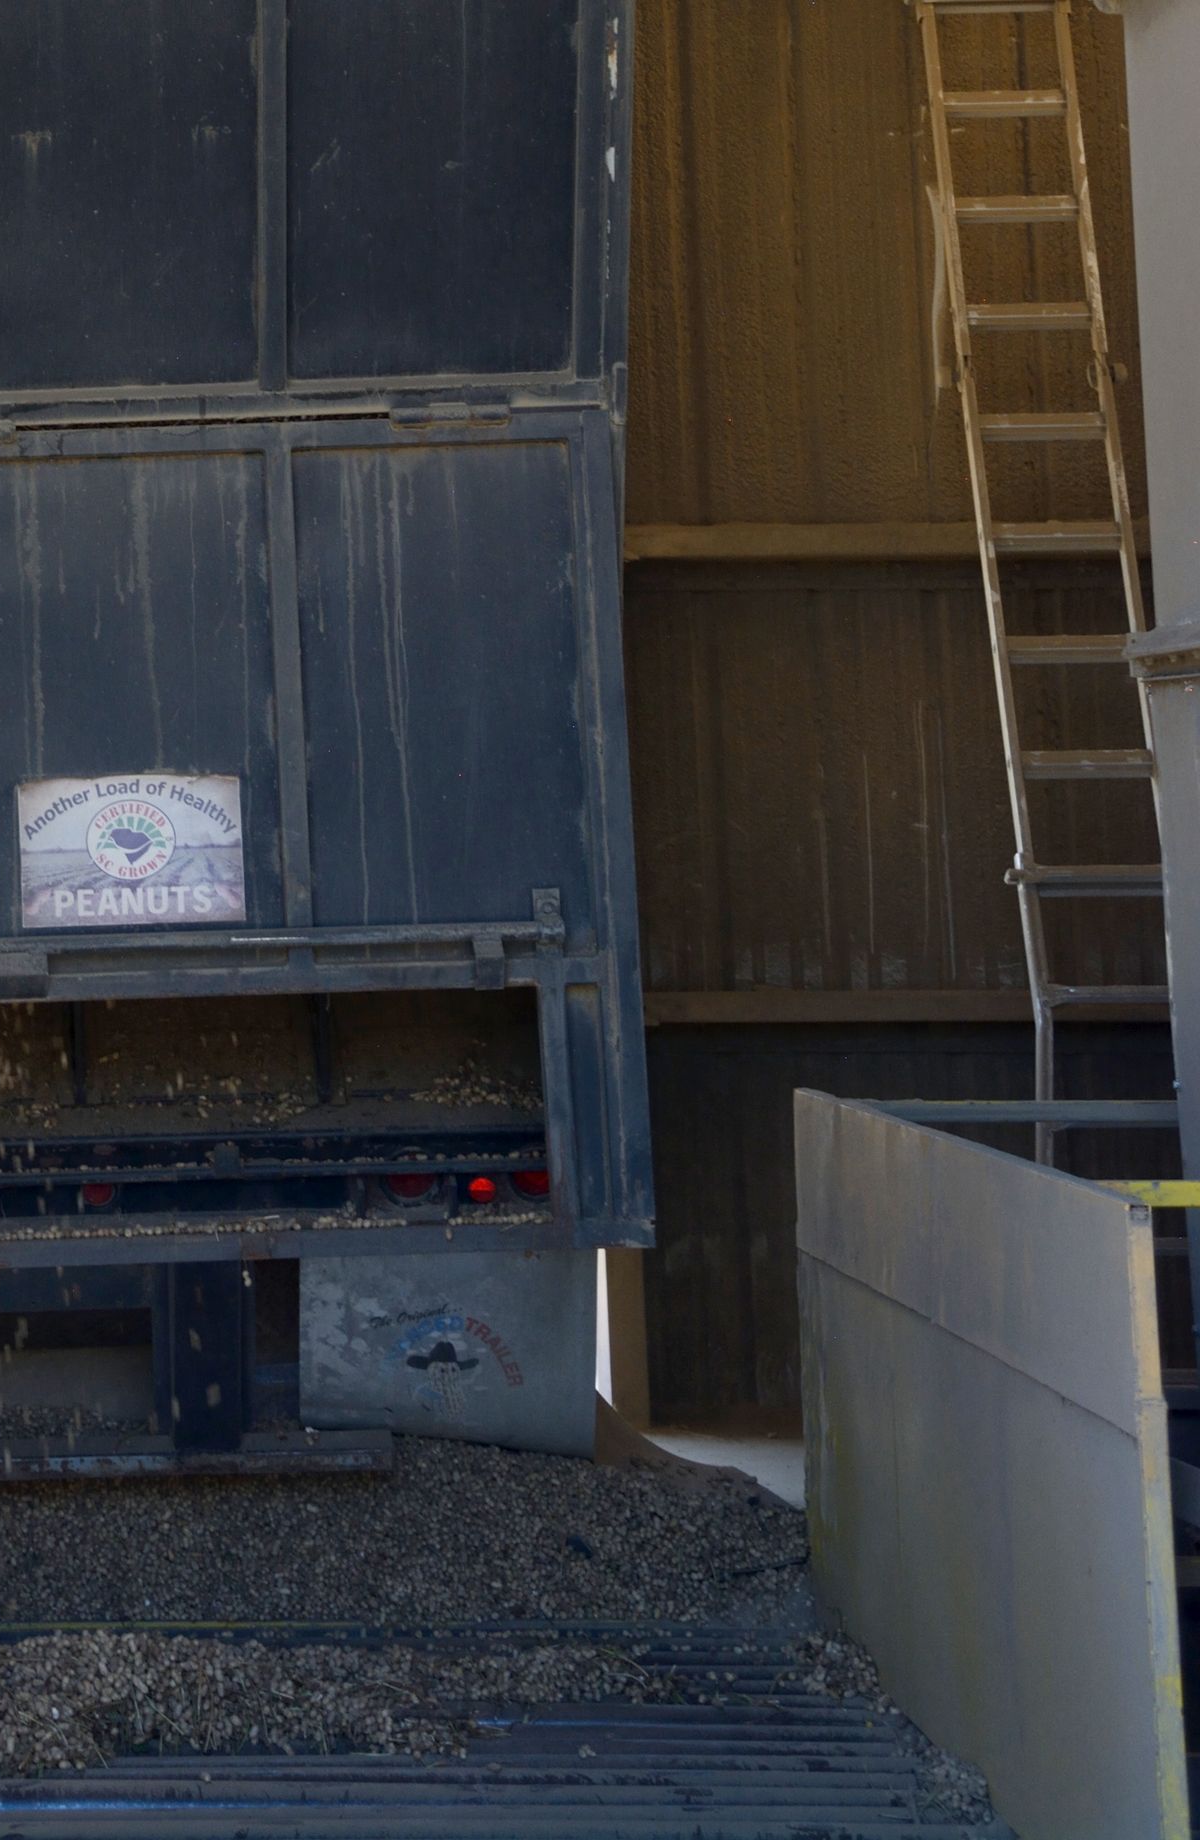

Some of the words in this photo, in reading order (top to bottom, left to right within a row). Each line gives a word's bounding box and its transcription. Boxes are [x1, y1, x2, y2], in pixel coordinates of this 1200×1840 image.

[23, 788, 91, 840] Another
[95, 779, 141, 798] Load
[146, 781, 168, 796] of
[169, 785, 238, 835] Healthy
[94, 802, 167, 830] CERTIFIED
[95, 853, 114, 871] SC
[118, 850, 167, 878] GROWN
[52, 885, 212, 918] PEANUTS
[465, 1315, 525, 1387] TRAILER
